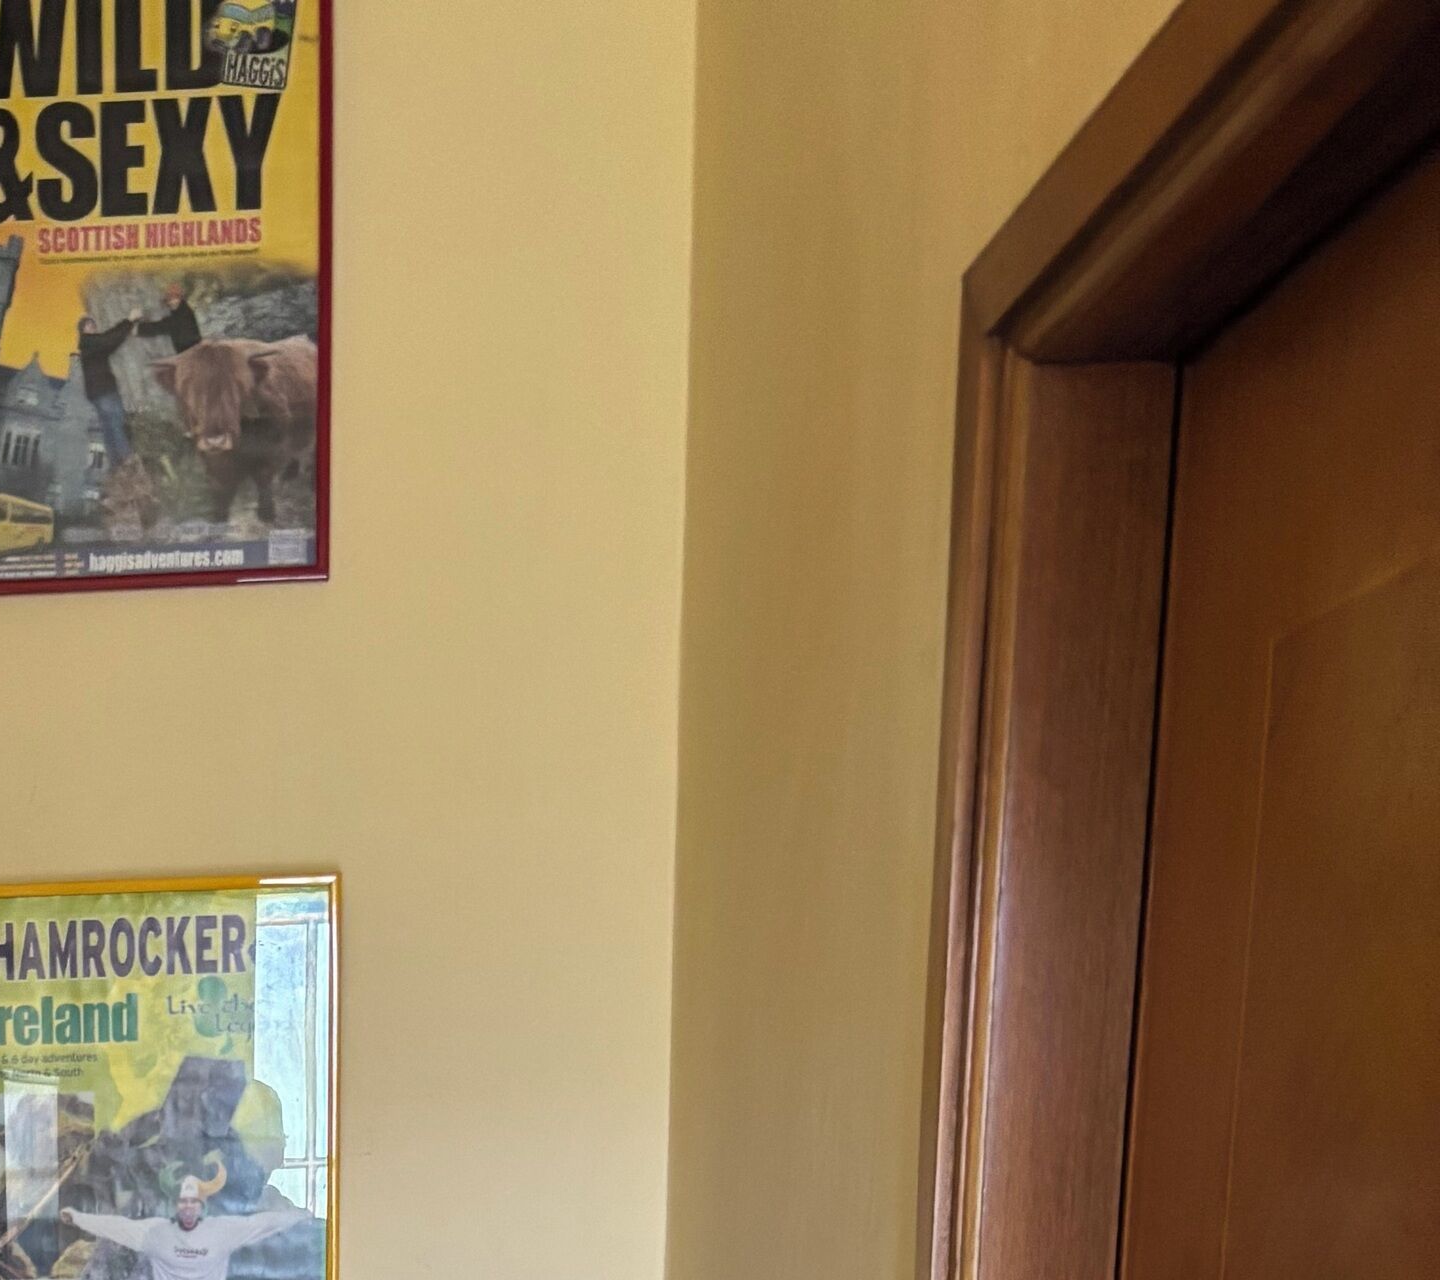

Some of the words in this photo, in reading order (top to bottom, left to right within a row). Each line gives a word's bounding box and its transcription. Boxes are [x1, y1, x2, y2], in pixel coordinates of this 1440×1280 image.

[38, 226, 139, 253] SCOTTISH
[145, 217, 262, 249] HIGHLANDS
[89, 549, 244, 573] haggisadventures.com
[166, 994, 210, 1015] Live
[21, 1053, 39, 1066] day
[41, 1053, 98, 1064] adventures
